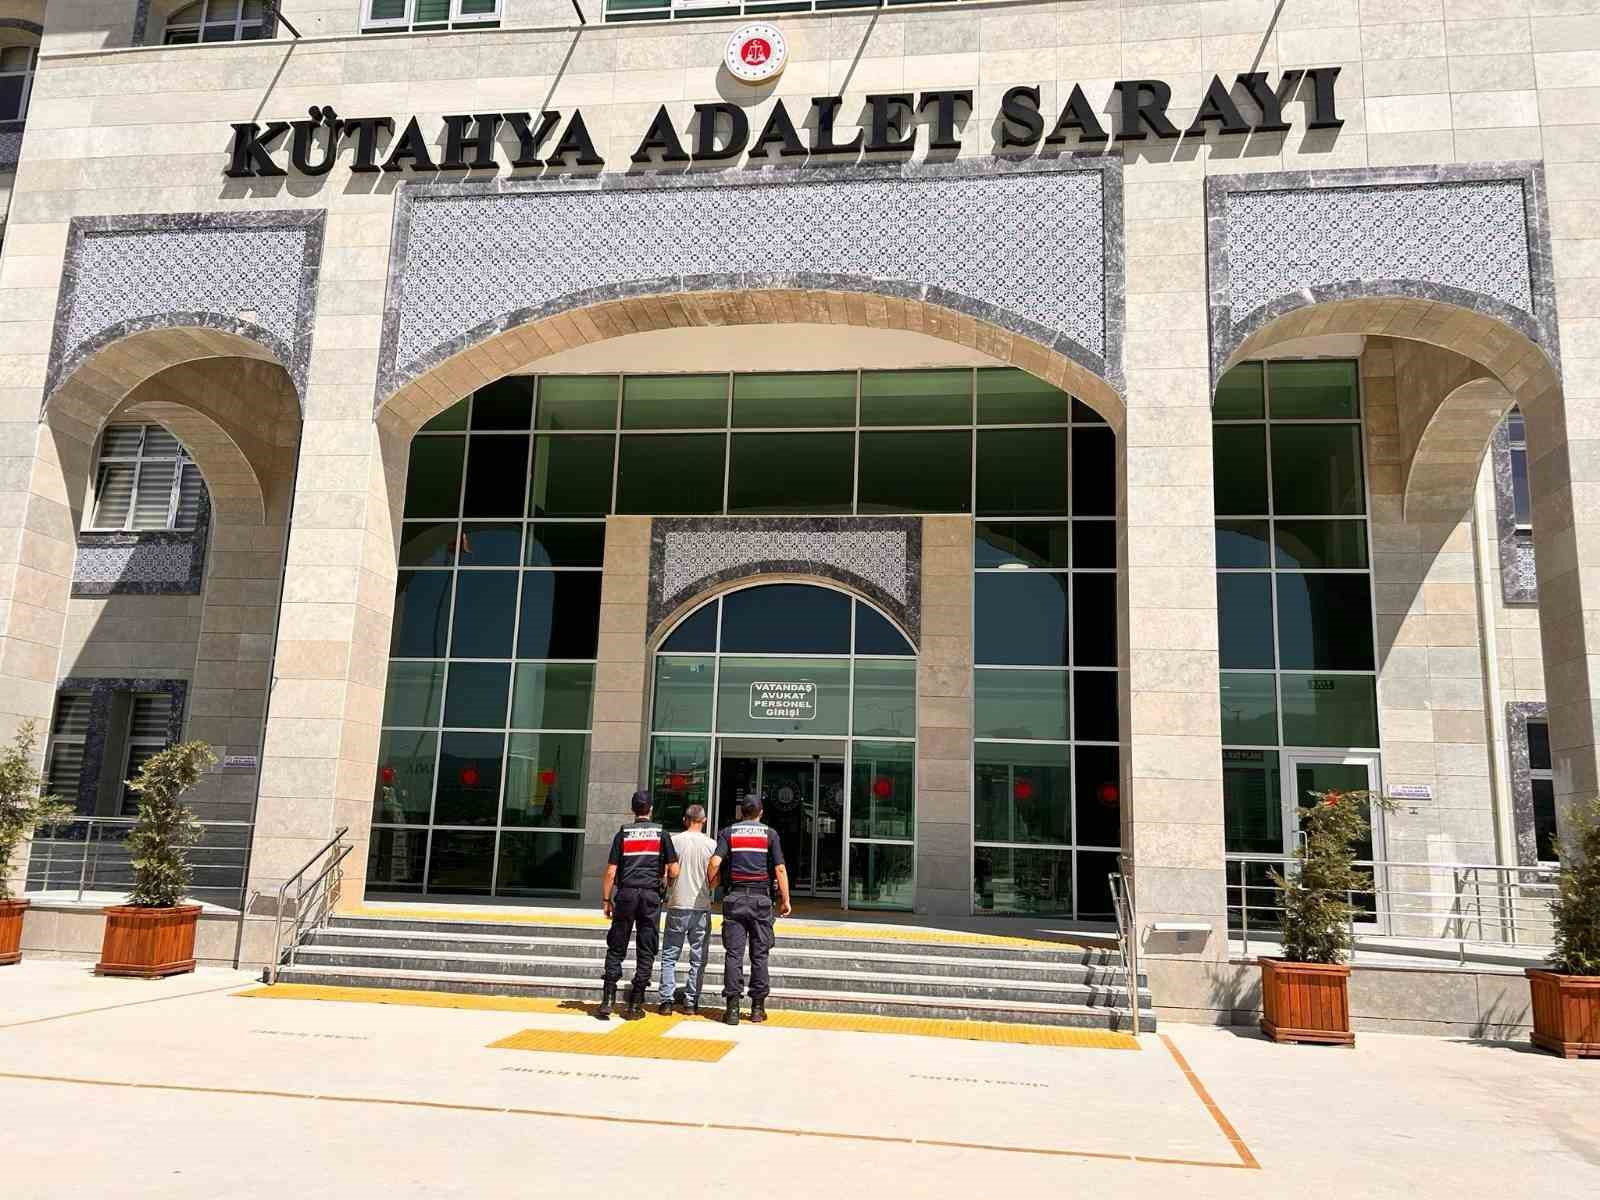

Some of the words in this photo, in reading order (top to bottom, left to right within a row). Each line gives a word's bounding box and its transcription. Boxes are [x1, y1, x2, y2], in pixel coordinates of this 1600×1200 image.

[225, 105, 605, 178] KÜTAHYA
[630, 90, 973, 163] ADALET
[1001, 67, 1345, 148] SARAYI
[755, 683, 812, 692] VATANDAŞ
[761, 692, 806, 700] AVUKAT
[754, 700, 813, 708] PERSONEL
